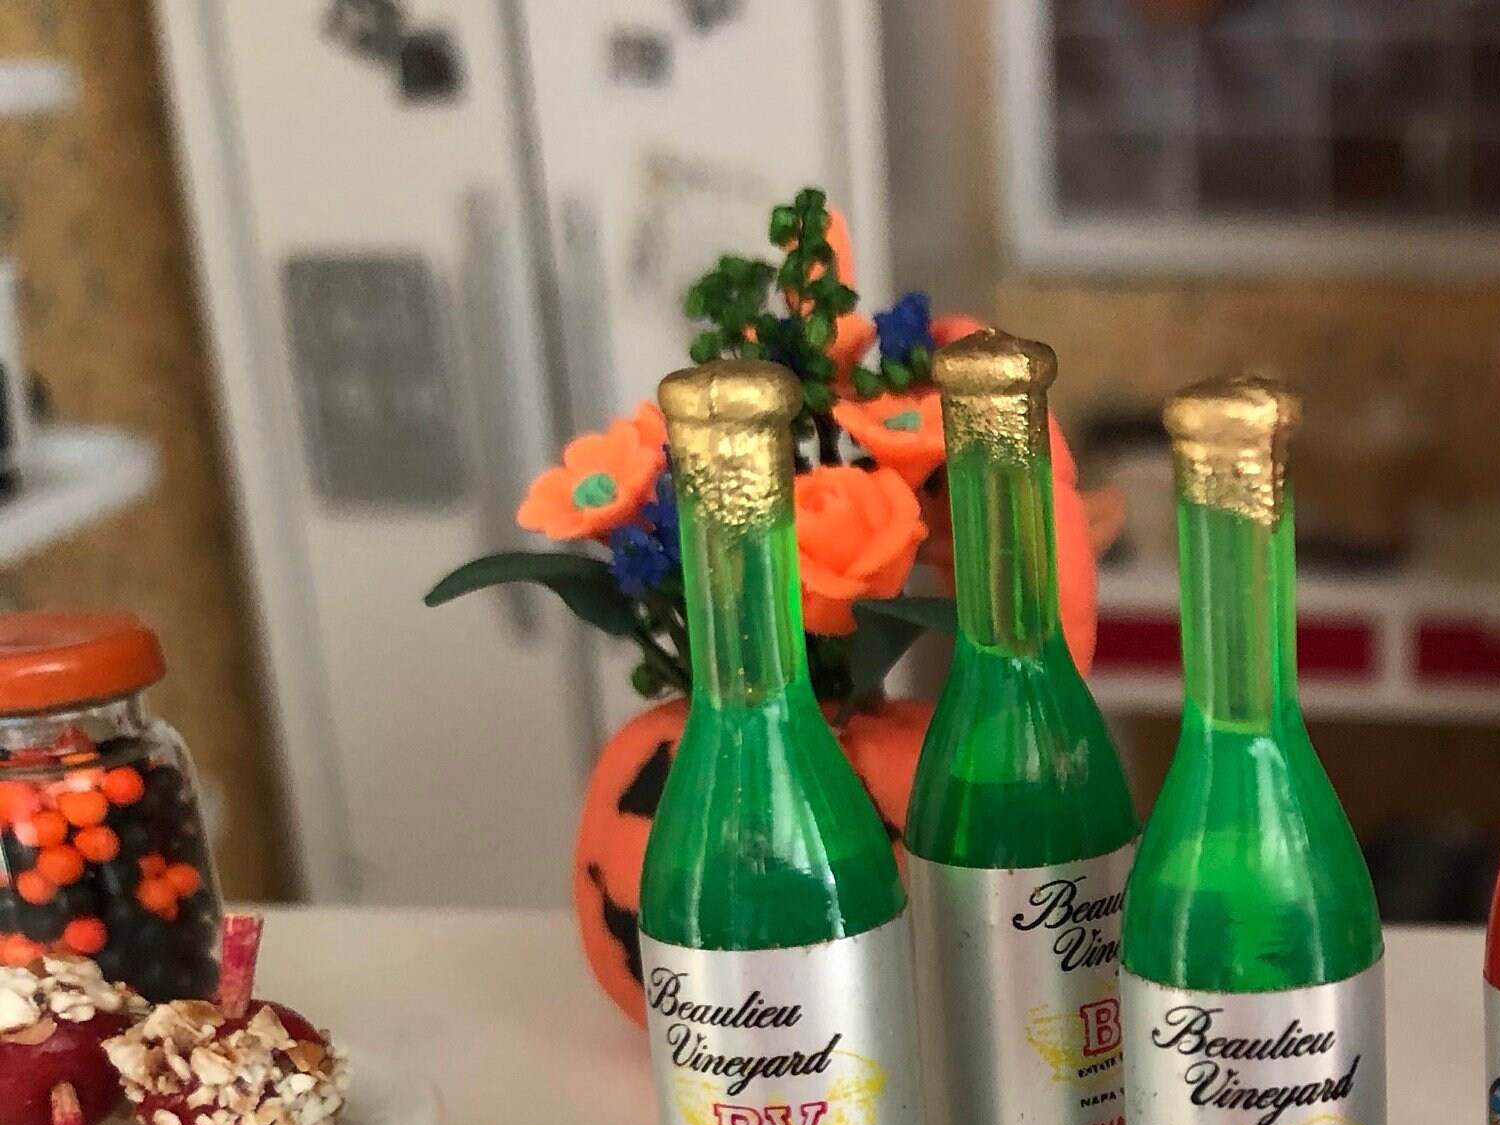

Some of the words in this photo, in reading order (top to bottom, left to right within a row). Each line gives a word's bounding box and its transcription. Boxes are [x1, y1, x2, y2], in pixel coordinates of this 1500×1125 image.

[1012, 875, 1123, 931] Beau
[649, 967, 803, 1026] Beaulieu
[1080, 998, 1122, 1057] B
[1152, 1005, 1335, 1061] Beaulieu
[667, 1023, 842, 1096] Vineyard
[1080, 1090, 1117, 1108] NAPA
